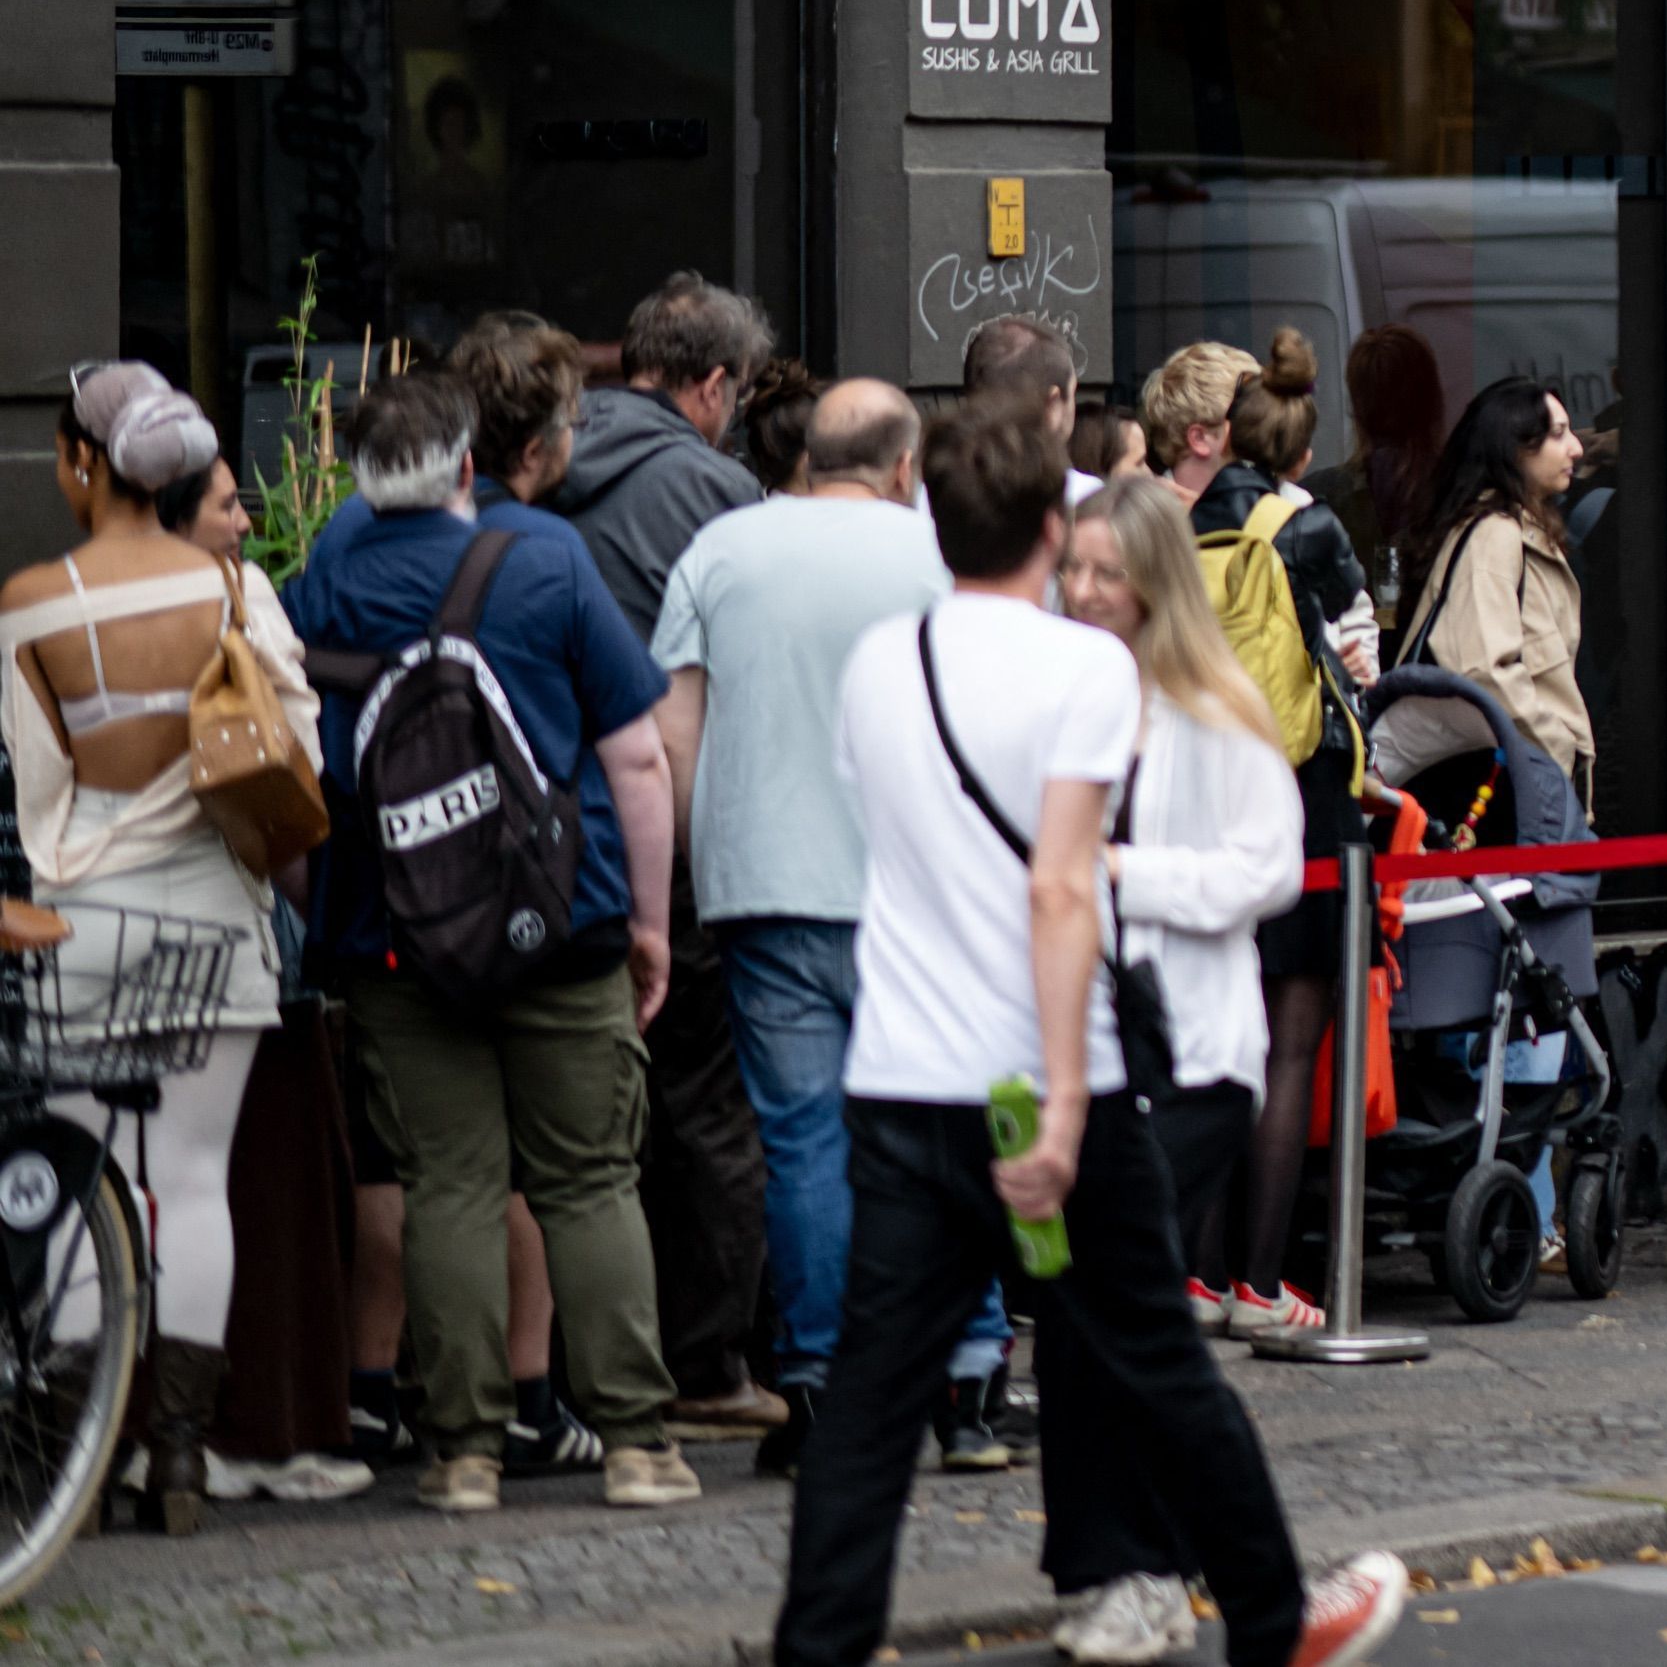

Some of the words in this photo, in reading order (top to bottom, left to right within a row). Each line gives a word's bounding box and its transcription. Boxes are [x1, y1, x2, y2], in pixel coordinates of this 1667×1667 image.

[921, 47, 981, 71] SUSHIS
[986, 49, 1001, 72] &
[1006, 48, 1045, 73] ASIA
[1051, 49, 1100, 75] GRILL
